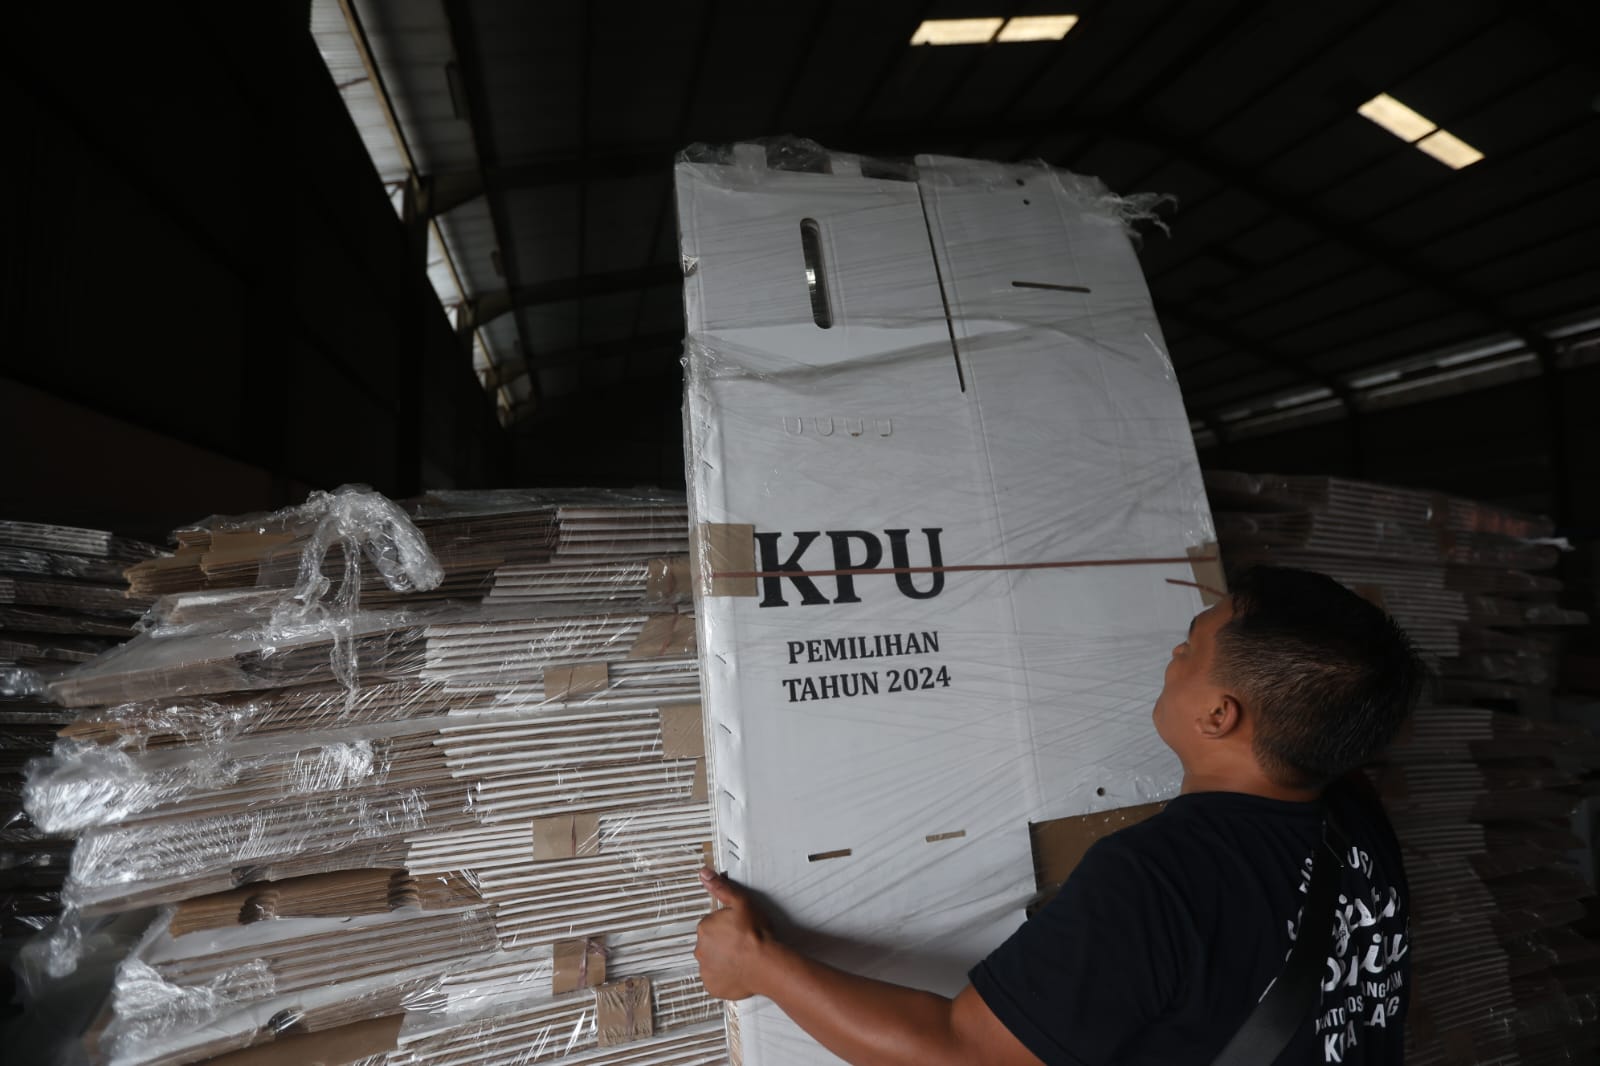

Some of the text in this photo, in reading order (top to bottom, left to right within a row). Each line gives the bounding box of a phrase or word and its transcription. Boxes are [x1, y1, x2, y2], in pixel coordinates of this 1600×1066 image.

[753, 528, 945, 608] KPU
[787, 631, 940, 664] PEMILIHAN
[782, 665, 951, 702] TAHUN 2024
